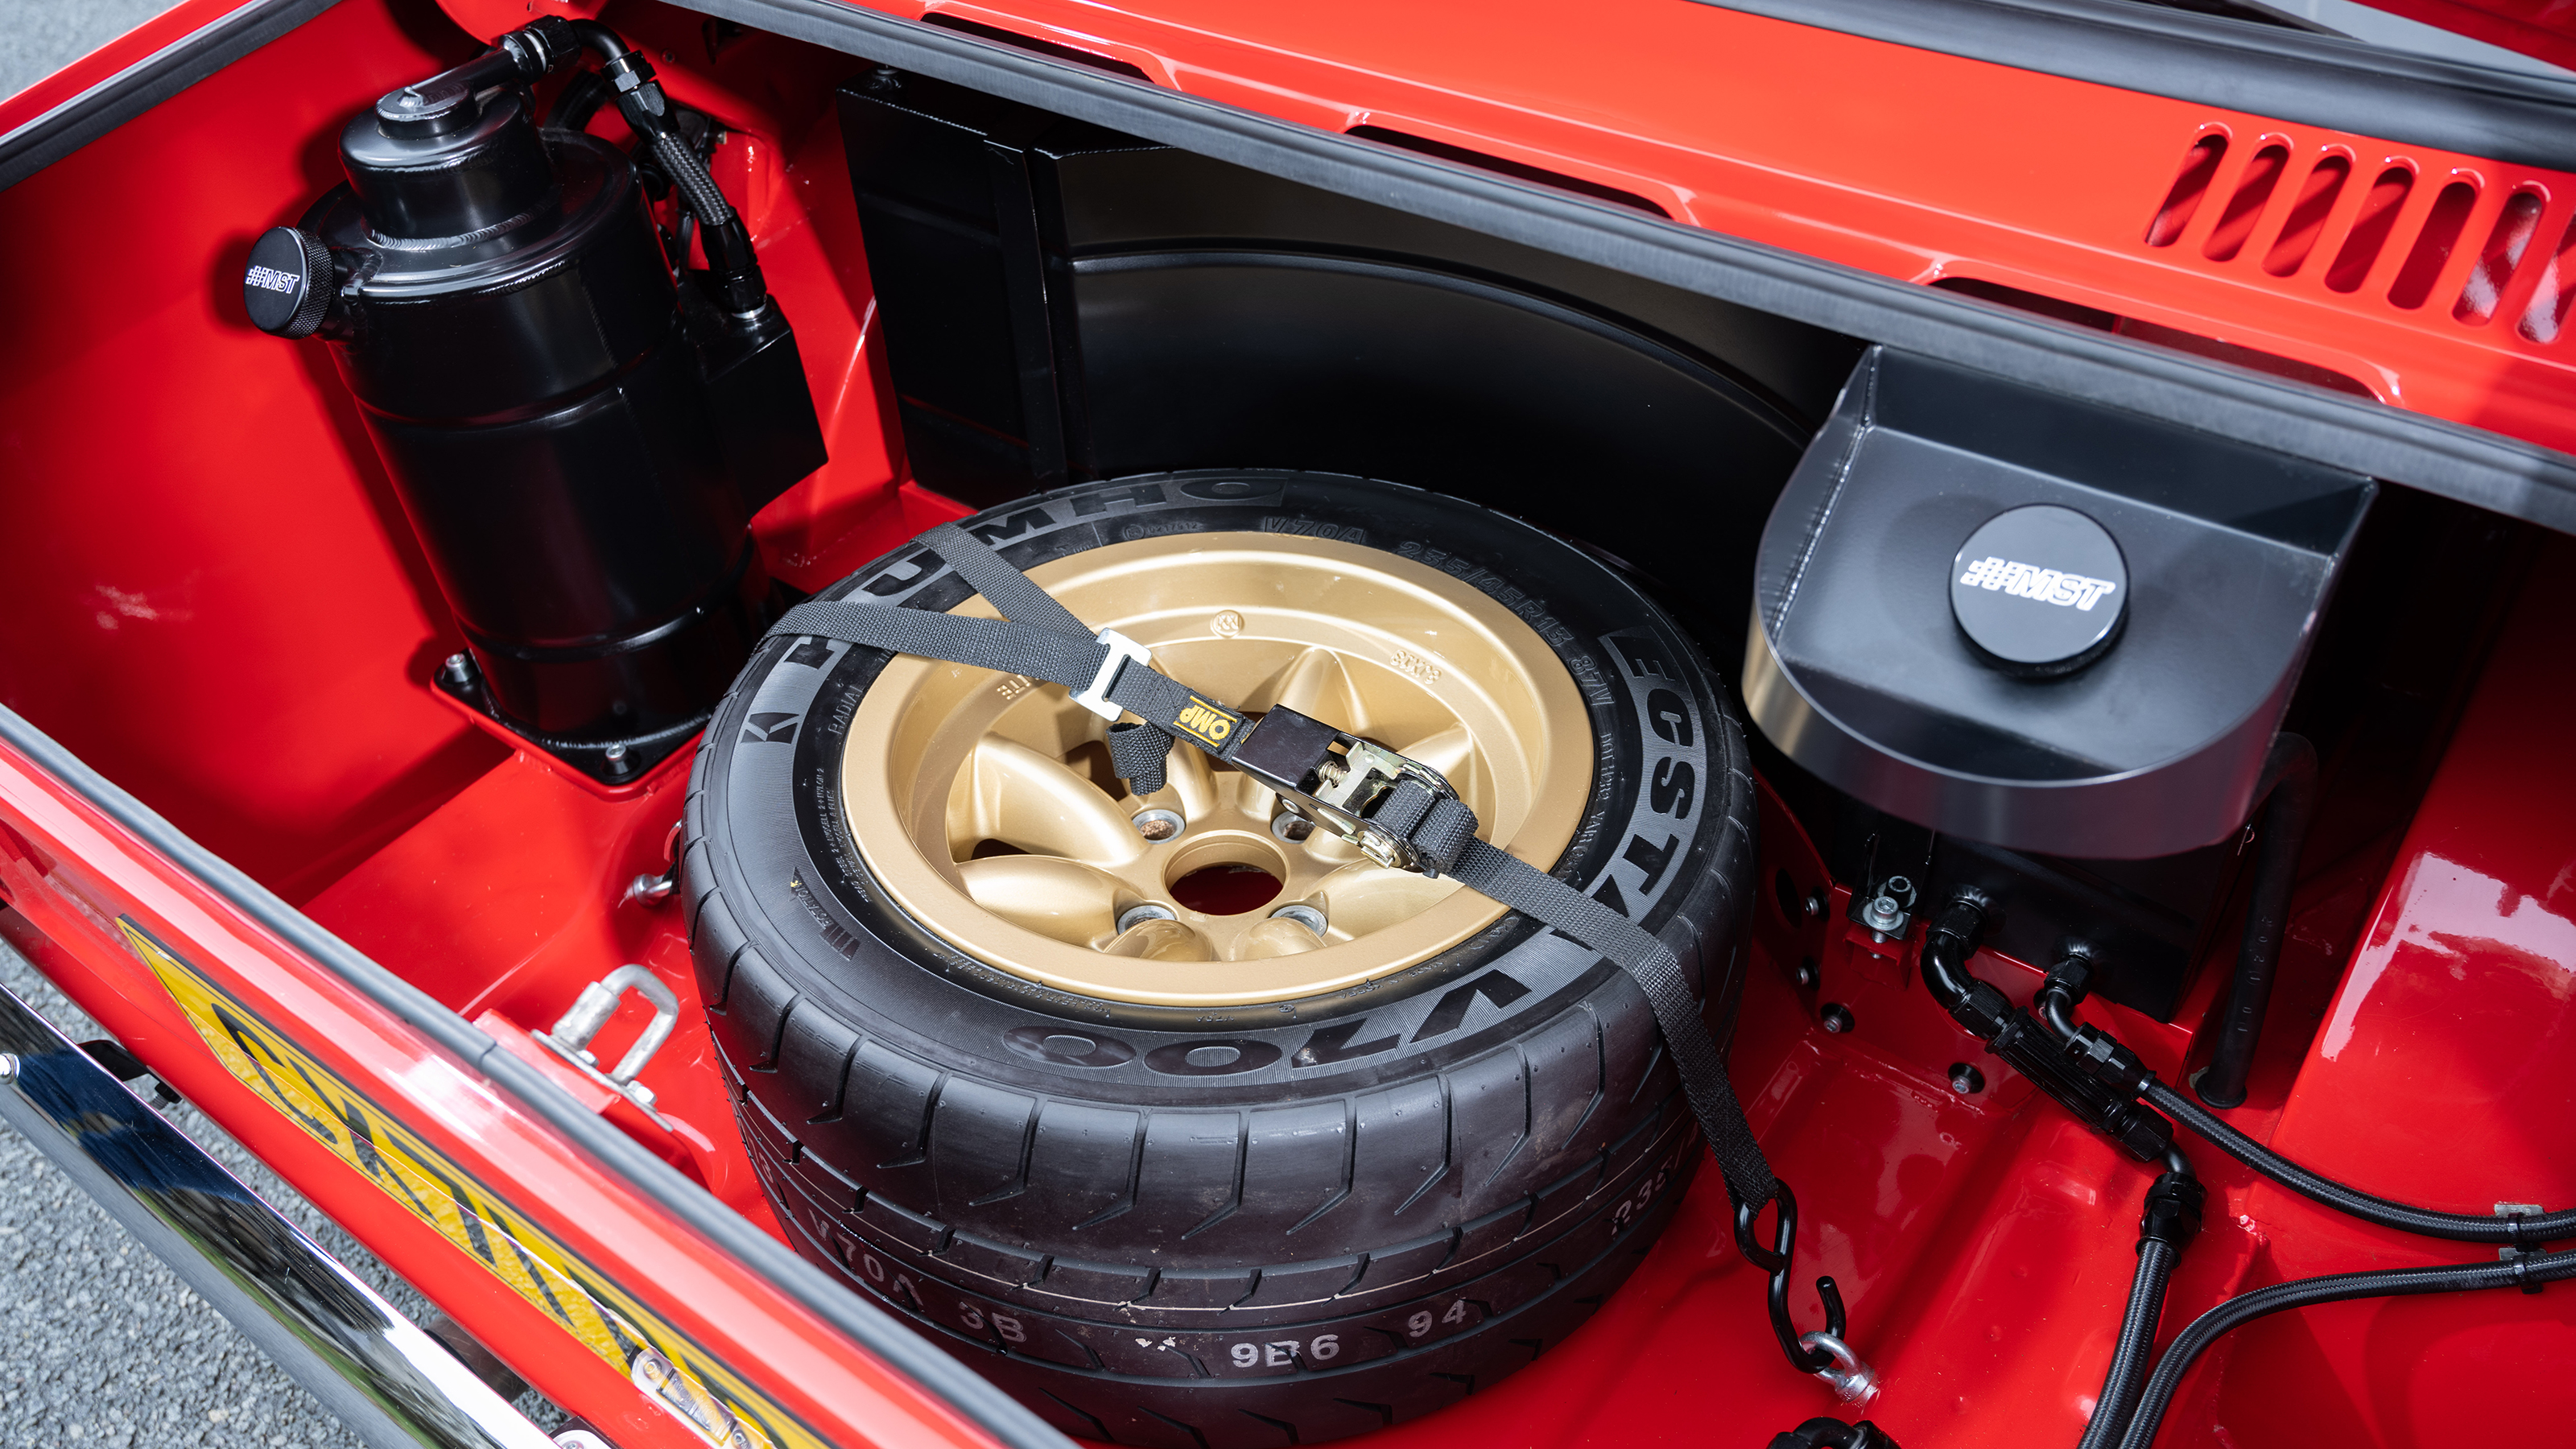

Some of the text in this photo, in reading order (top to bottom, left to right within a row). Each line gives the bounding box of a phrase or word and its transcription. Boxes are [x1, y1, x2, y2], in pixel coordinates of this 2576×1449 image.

[246, 265, 300, 295] #MST
[1960, 556, 2116, 612] #MST
[1396, 540, 1575, 647] 235/45R13
[1570, 655, 1615, 706] 87V
[1179, 704, 1231, 741] OMP
[1003, 969, 1531, 1076] V700
[1406, 1298, 1468, 1338] 94
